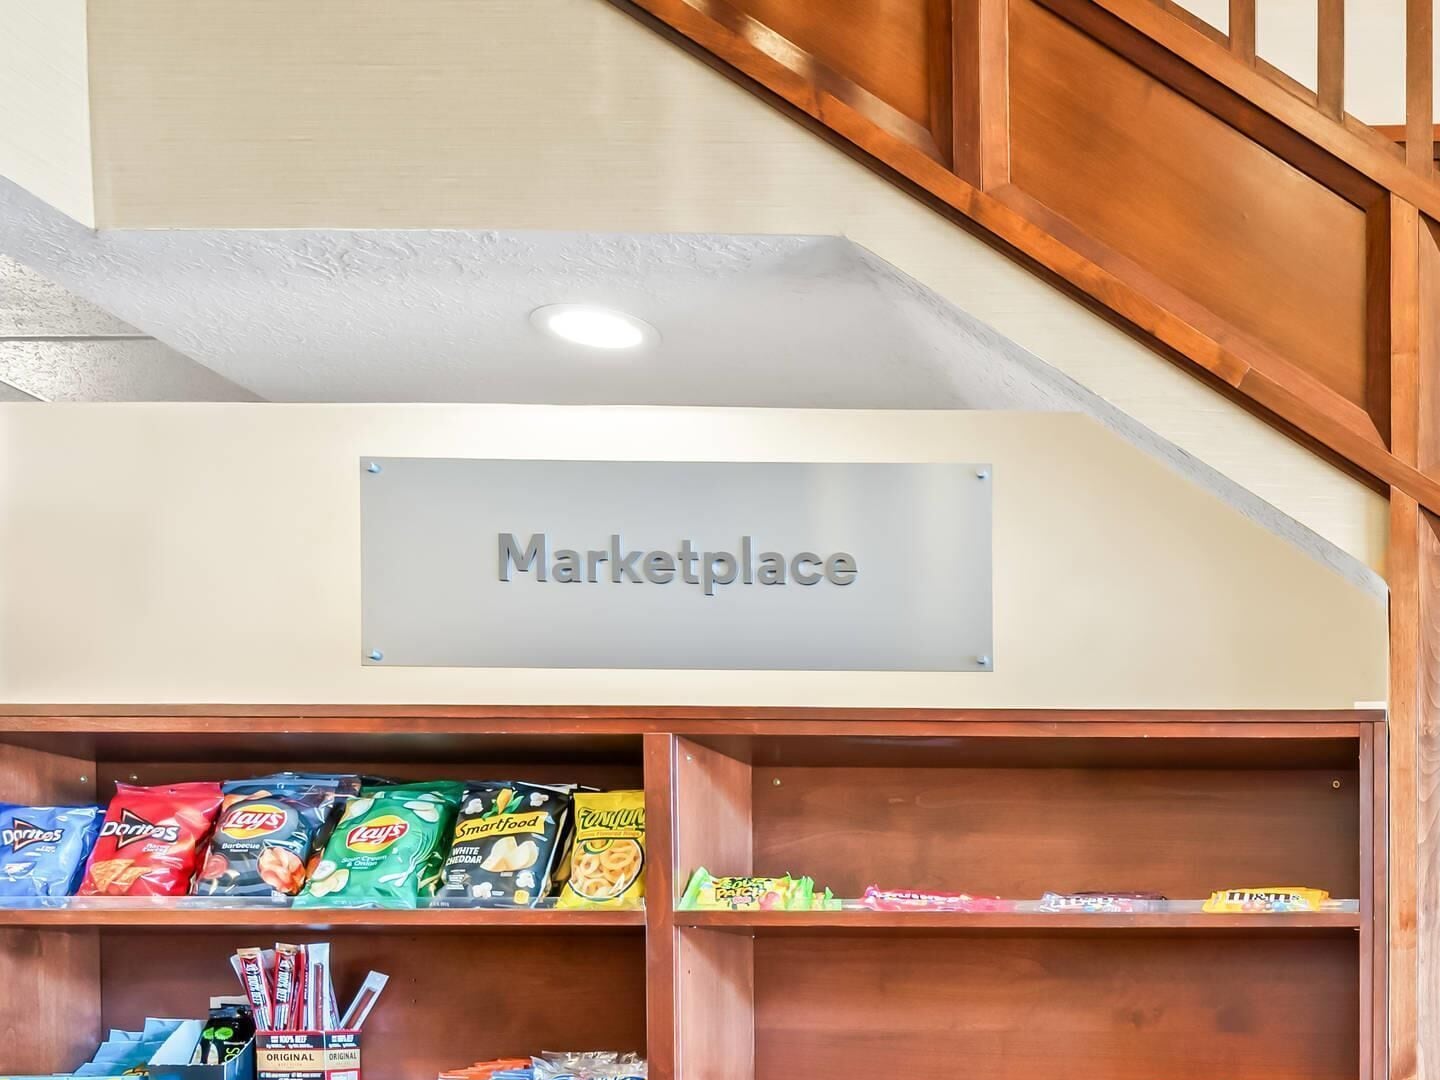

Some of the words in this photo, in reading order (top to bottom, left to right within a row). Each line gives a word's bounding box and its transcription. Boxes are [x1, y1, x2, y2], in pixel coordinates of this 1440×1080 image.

[498, 533, 858, 596] Marketplace
[457, 815, 540, 838] Smartfood
[578, 807, 645, 830] FUNYUN
[2, 828, 62, 845] Doritos
[101, 821, 179, 842] Doritos
[446, 855, 482, 864] CHEDDAR
[452, 847, 480, 855] WHITE
[267, 1053, 315, 1061] ORIGINAL
[329, 1052, 357, 1061] ORIGINAL
